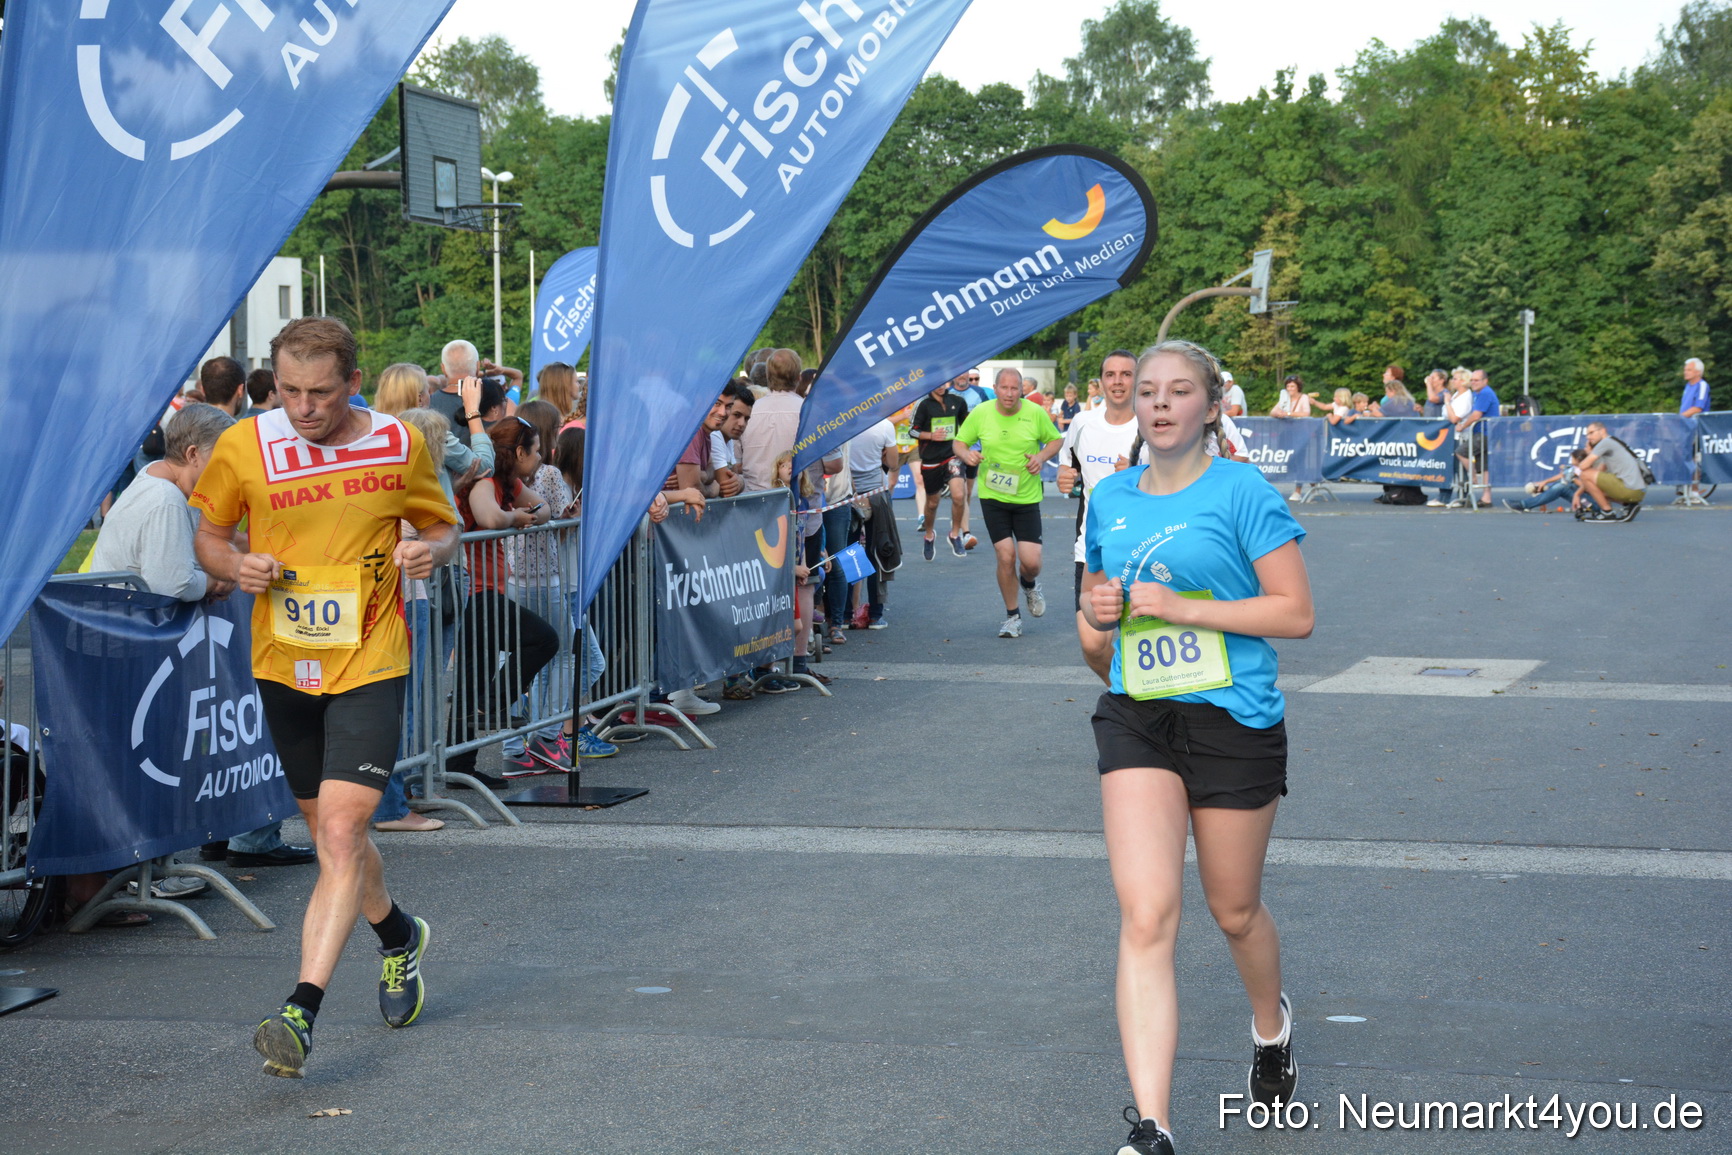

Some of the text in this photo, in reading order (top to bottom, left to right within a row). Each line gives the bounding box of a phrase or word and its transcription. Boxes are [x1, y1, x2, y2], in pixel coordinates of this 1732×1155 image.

[281, 0, 359, 91] AU
[777, 0, 916, 195] AUTOMOBI
[990, 232, 1136, 317] Druck und Medien
[854, 244, 1064, 368] Frischmann
[1330, 437, 1418, 458] Frischmann
[269, 471, 406, 512] MAX BÖGL
[991, 473, 1013, 487] 274
[1131, 532, 1163, 559] Schick
[1164, 522, 1187, 535] Bau
[665, 555, 767, 611] Frischmann
[284, 597, 341, 626] 910
[731, 600, 754, 626] Druck
[754, 596, 770, 620] und
[1137, 631, 1202, 671] 808
[1142, 676, 1160, 686] Laura
[1160, 670, 1205, 684] Guttenberger
